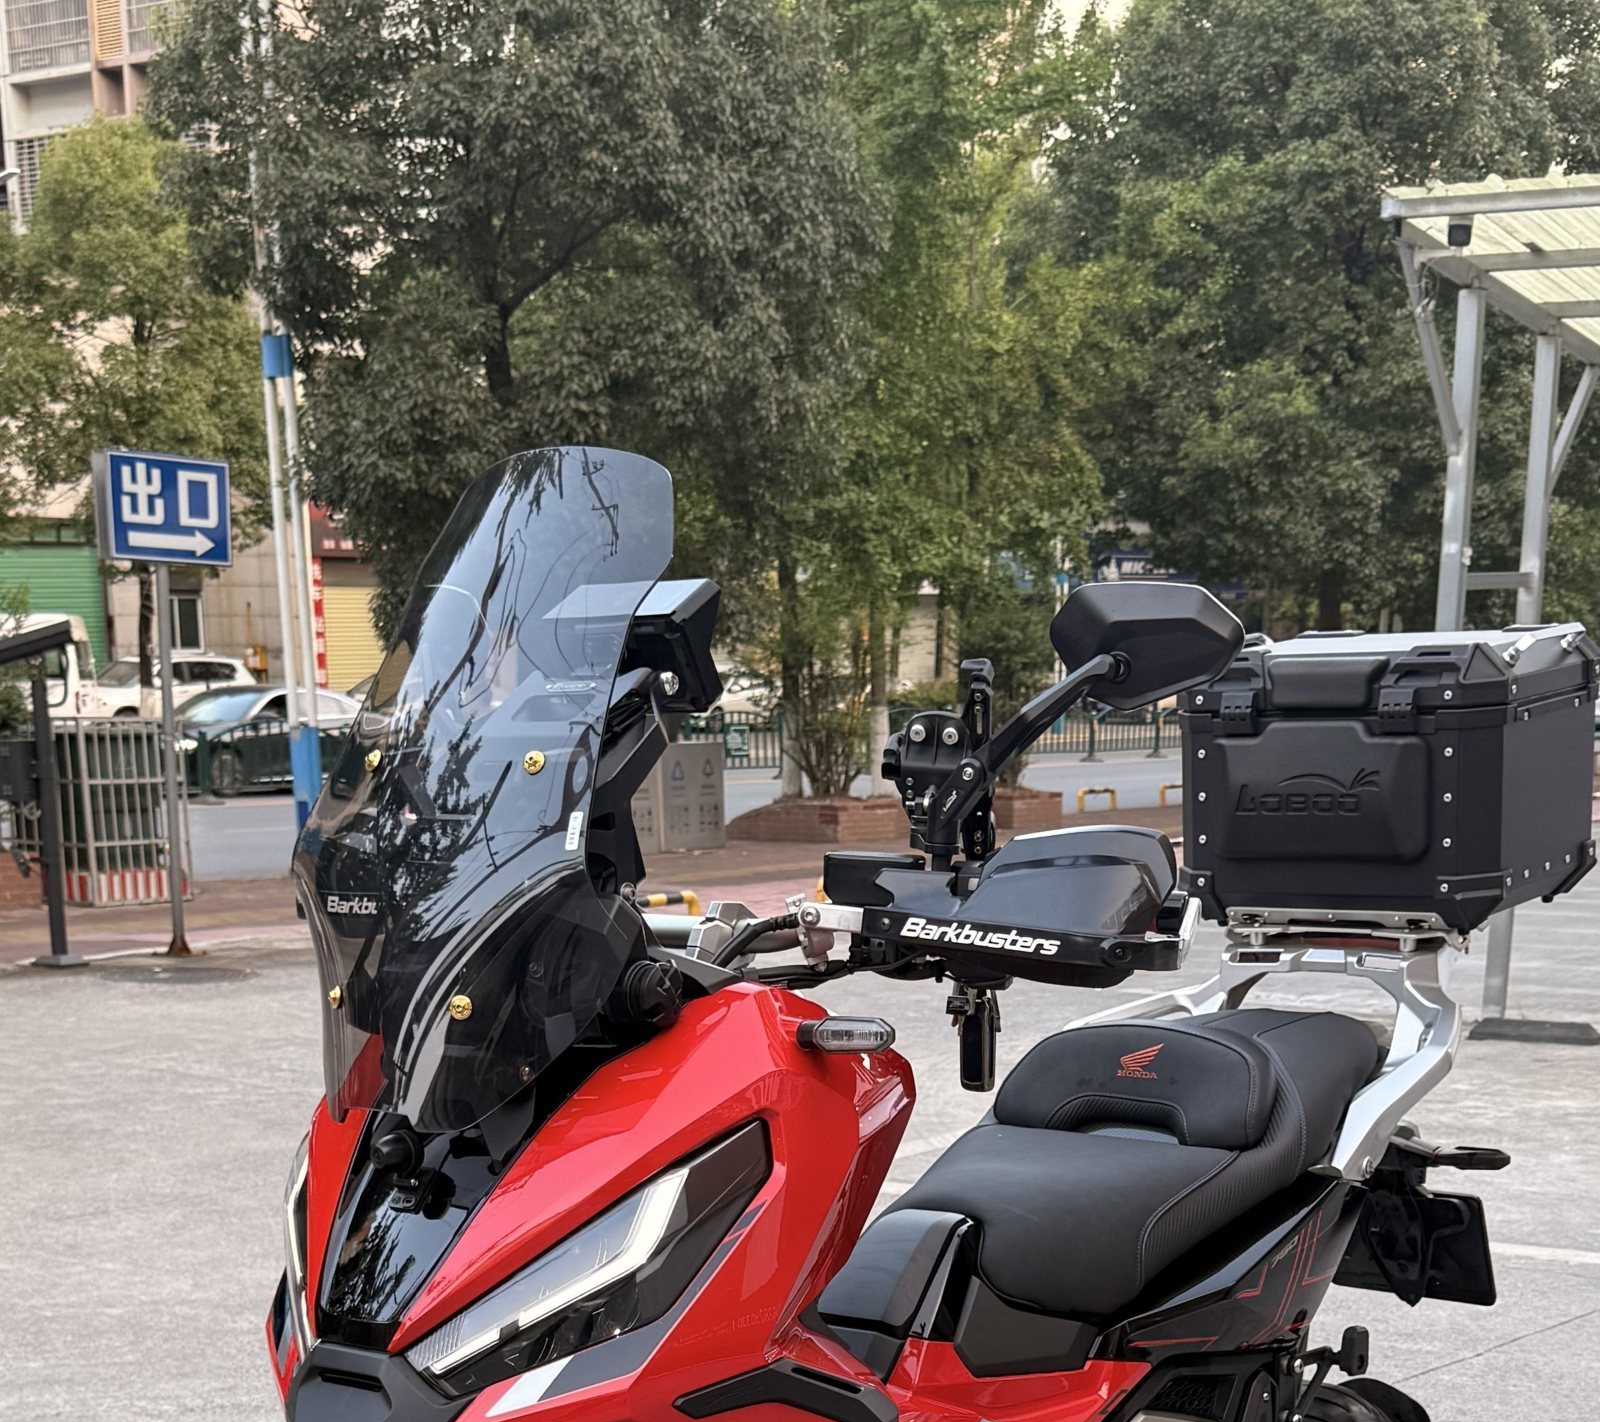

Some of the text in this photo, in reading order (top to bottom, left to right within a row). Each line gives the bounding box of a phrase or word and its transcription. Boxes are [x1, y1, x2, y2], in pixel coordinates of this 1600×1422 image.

[121, 462, 219, 529] 出口
[900, 917, 1061, 955] Barkbusters
[1117, 1069, 1158, 1079] HONDA
